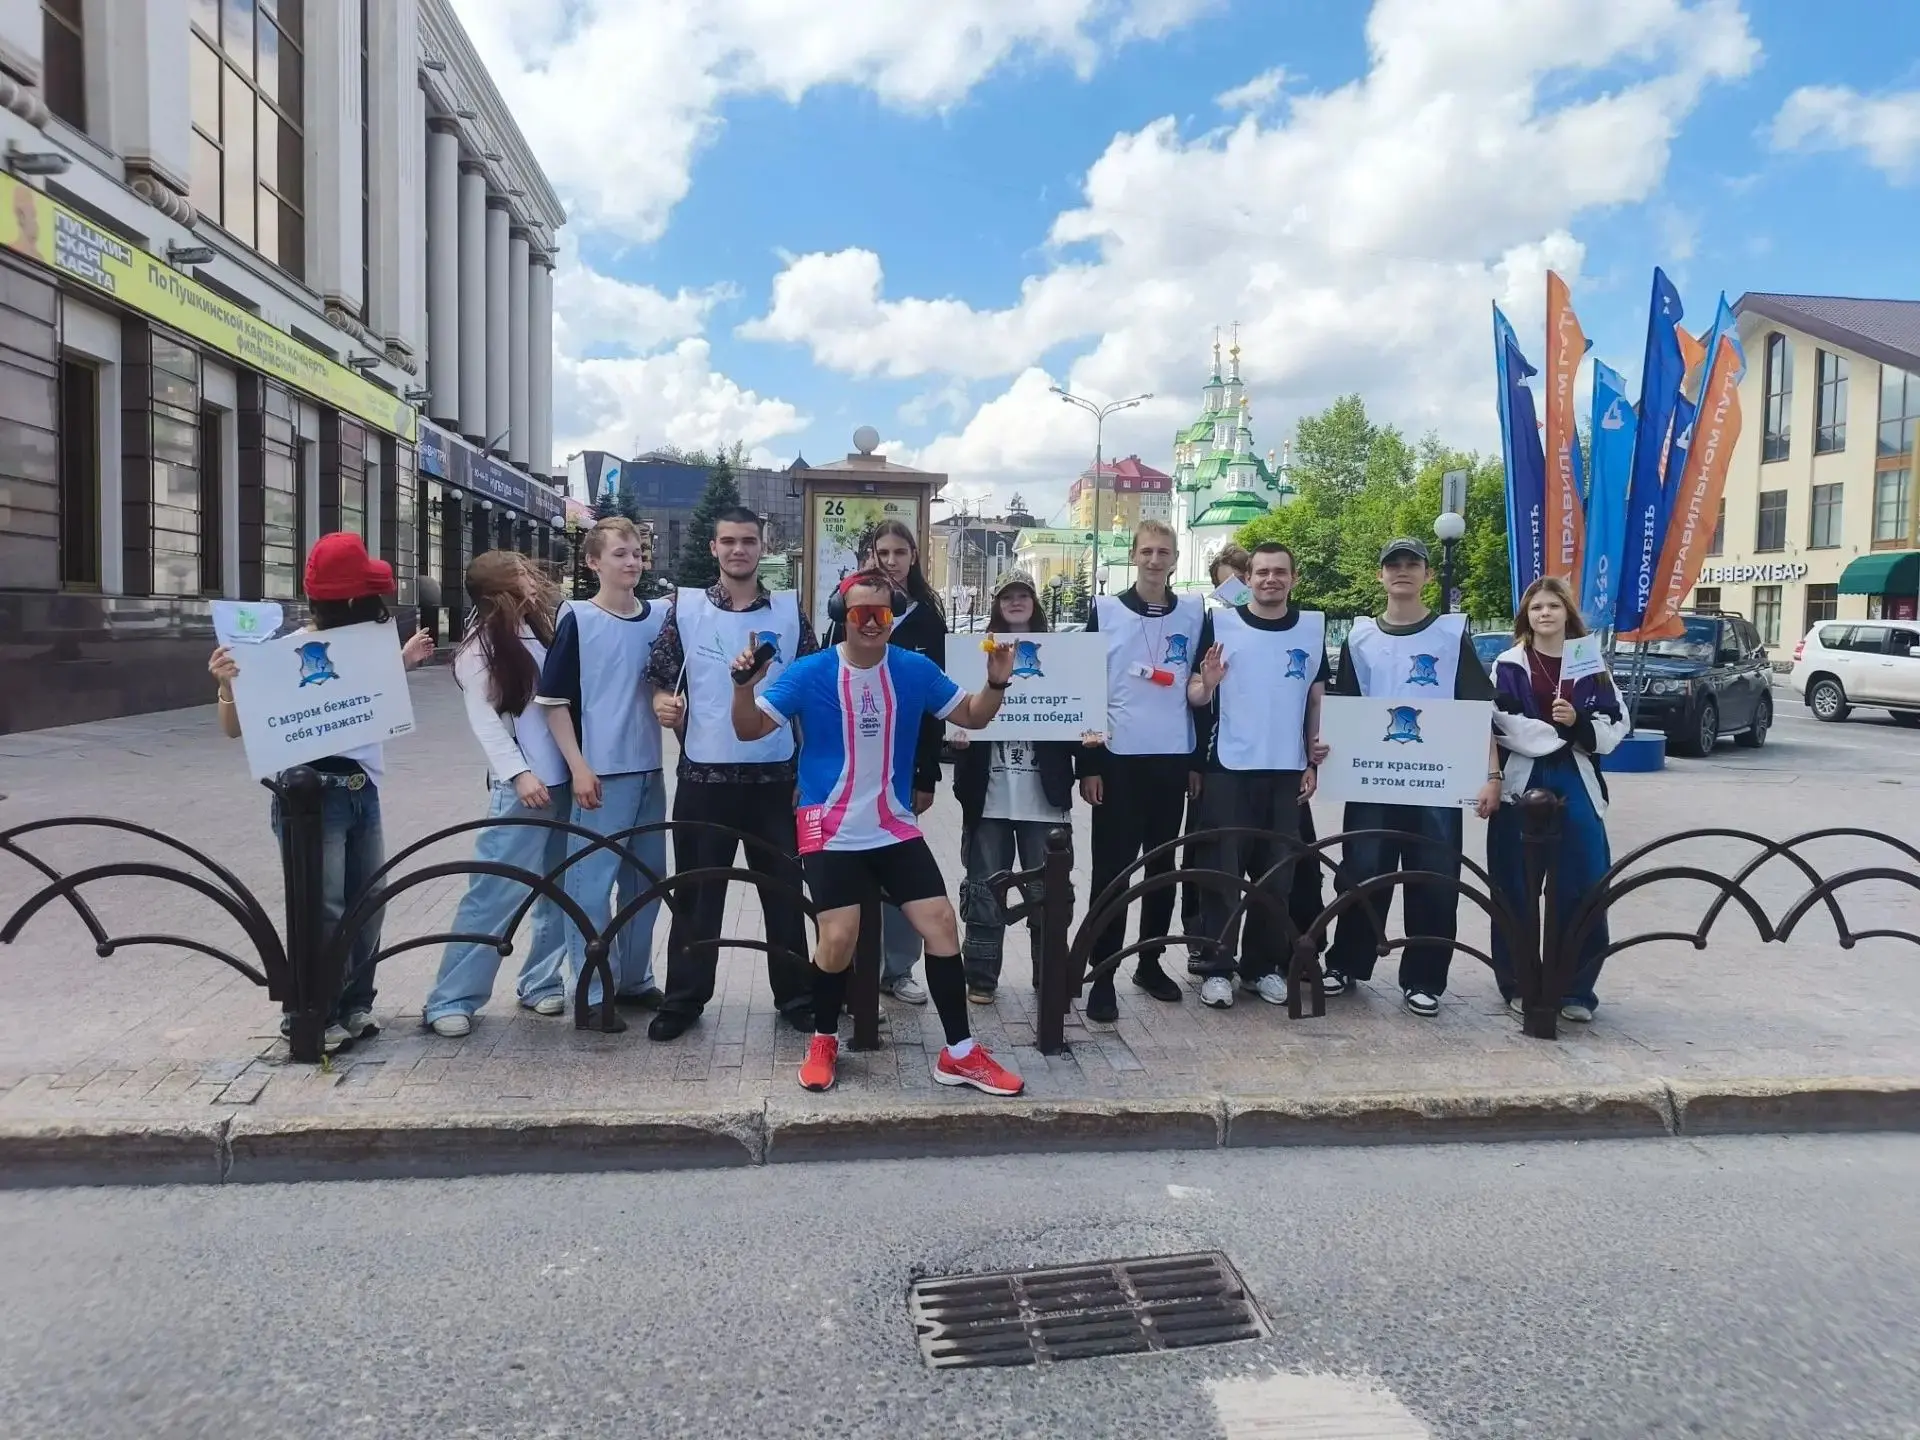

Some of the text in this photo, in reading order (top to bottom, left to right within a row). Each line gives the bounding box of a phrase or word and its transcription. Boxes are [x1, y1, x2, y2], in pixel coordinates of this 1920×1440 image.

[56, 251, 114, 290] КАРТА
[148, 263, 168, 290] По
[169, 275, 244, 334] Пушкинской
[244, 322, 274, 347] карте
[275, 338, 287, 354] на
[824, 500, 845, 516] 26
[1669, 428, 1721, 590] ПРАВИЛЬНОМ
[1637, 504, 1655, 613] ТЮМЕНЬ
[267, 716, 277, 728] С
[280, 706, 321, 727] мэром
[324, 693, 371, 713] бежать
[998, 713, 1030, 722] твоя
[1033, 711, 1083, 724] победа!
[1030, 695, 1068, 706] старт
[285, 726, 313, 743] себя
[316, 709, 374, 737] уважать!
[1352, 758, 1383, 769] Беги
[1388, 759, 1443, 772] красиво
[1361, 776, 1445, 789] в этом сила!
